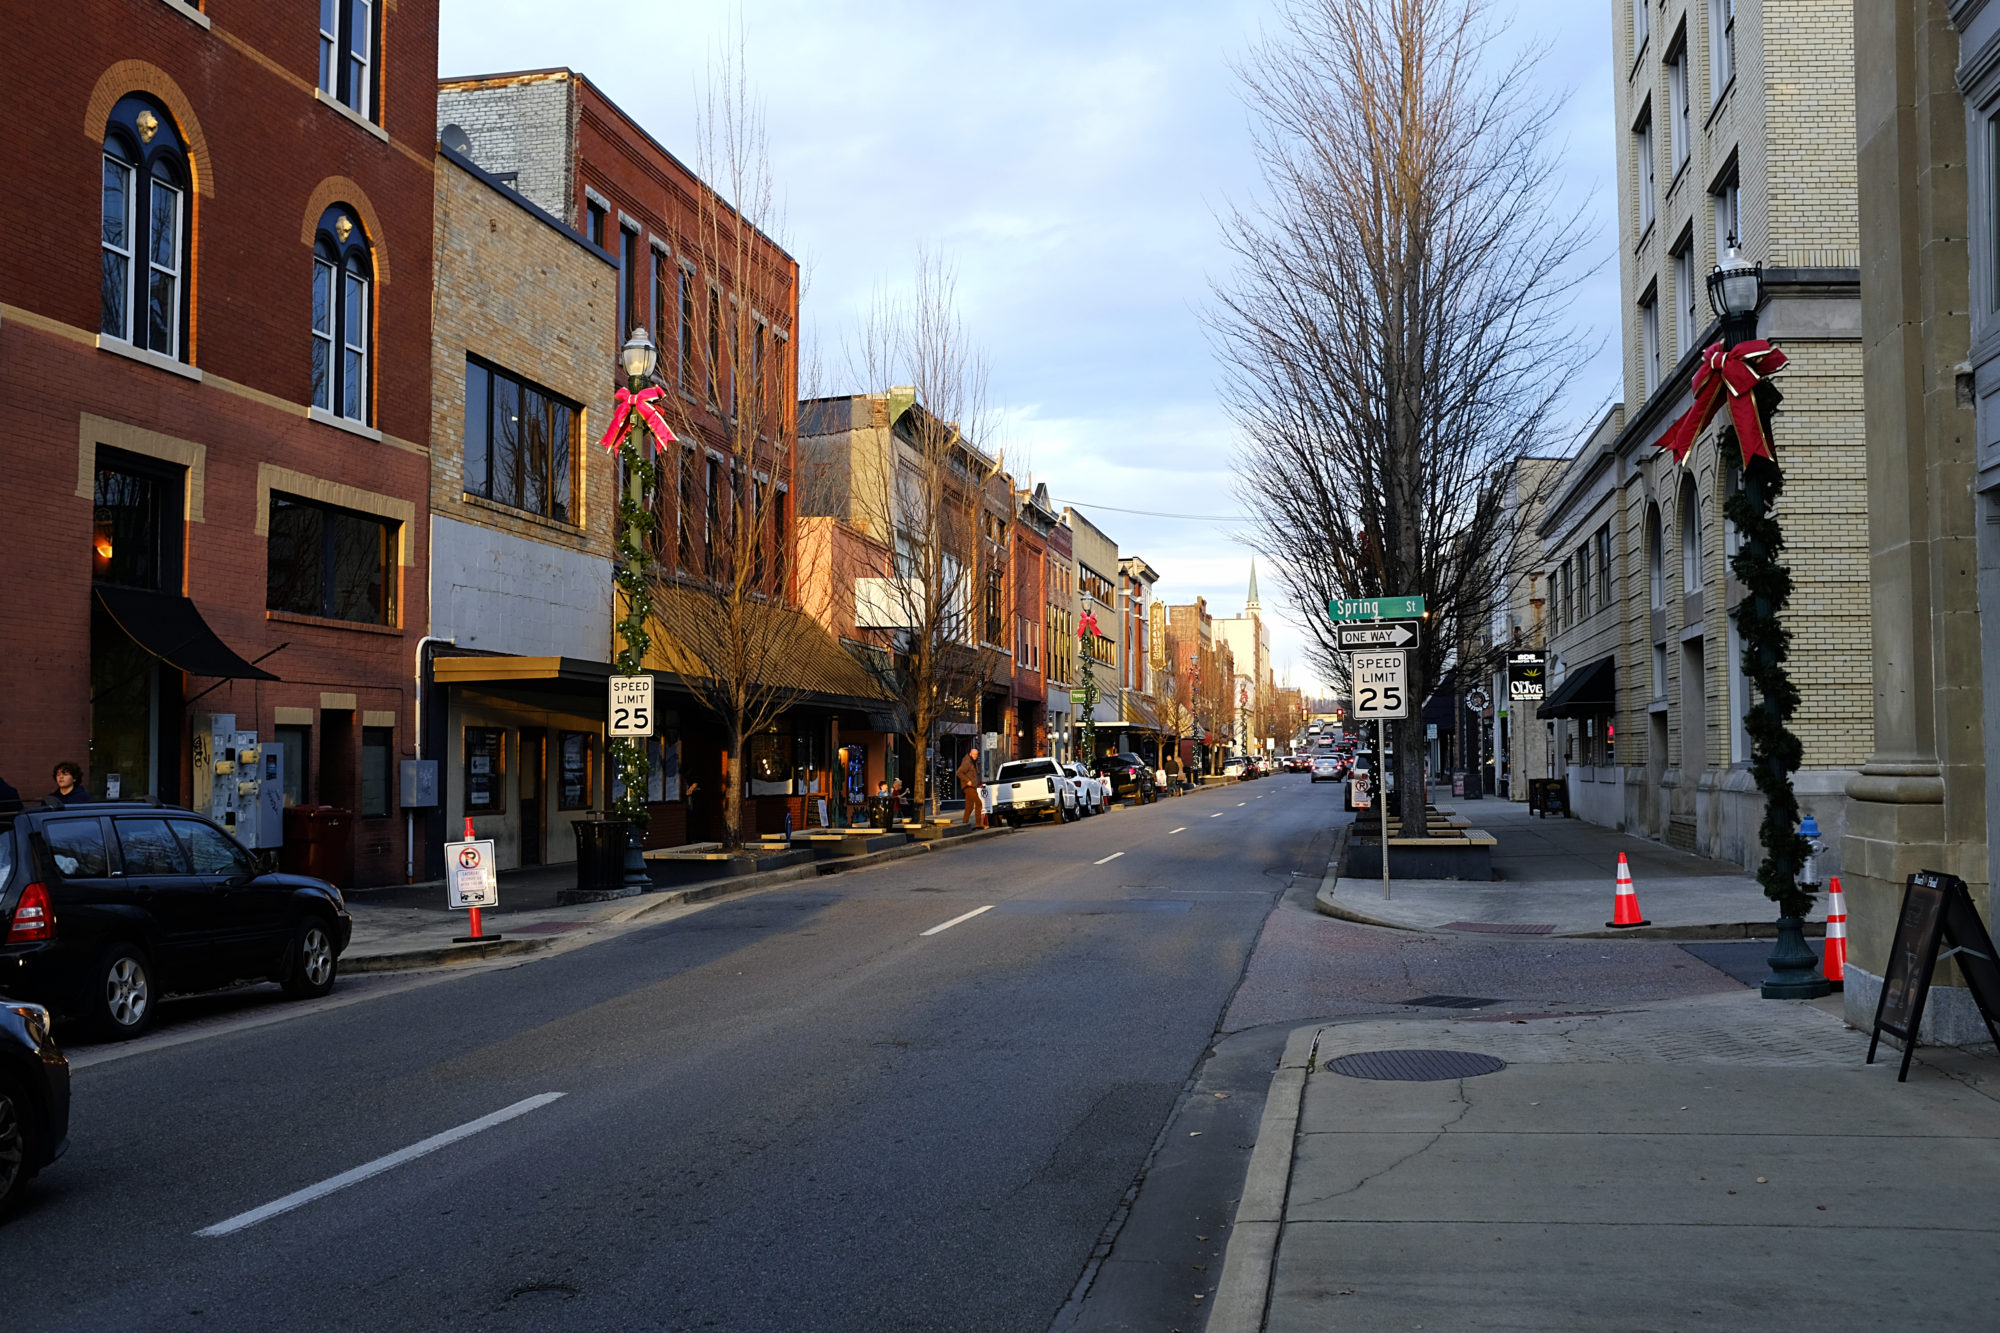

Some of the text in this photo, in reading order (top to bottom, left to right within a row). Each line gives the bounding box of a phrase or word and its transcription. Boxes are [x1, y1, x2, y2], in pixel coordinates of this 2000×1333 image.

[1337, 599, 1416, 618] Spring St
[1345, 631, 1393, 643] ONE WAY
[1357, 657, 1401, 669] SPEED
[1362, 672, 1397, 683] LIMIT
[613, 681, 649, 692] SPEED
[617, 694, 645, 704] LIMIT
[1359, 686, 1402, 711] 25
[614, 708, 649, 729] 25
